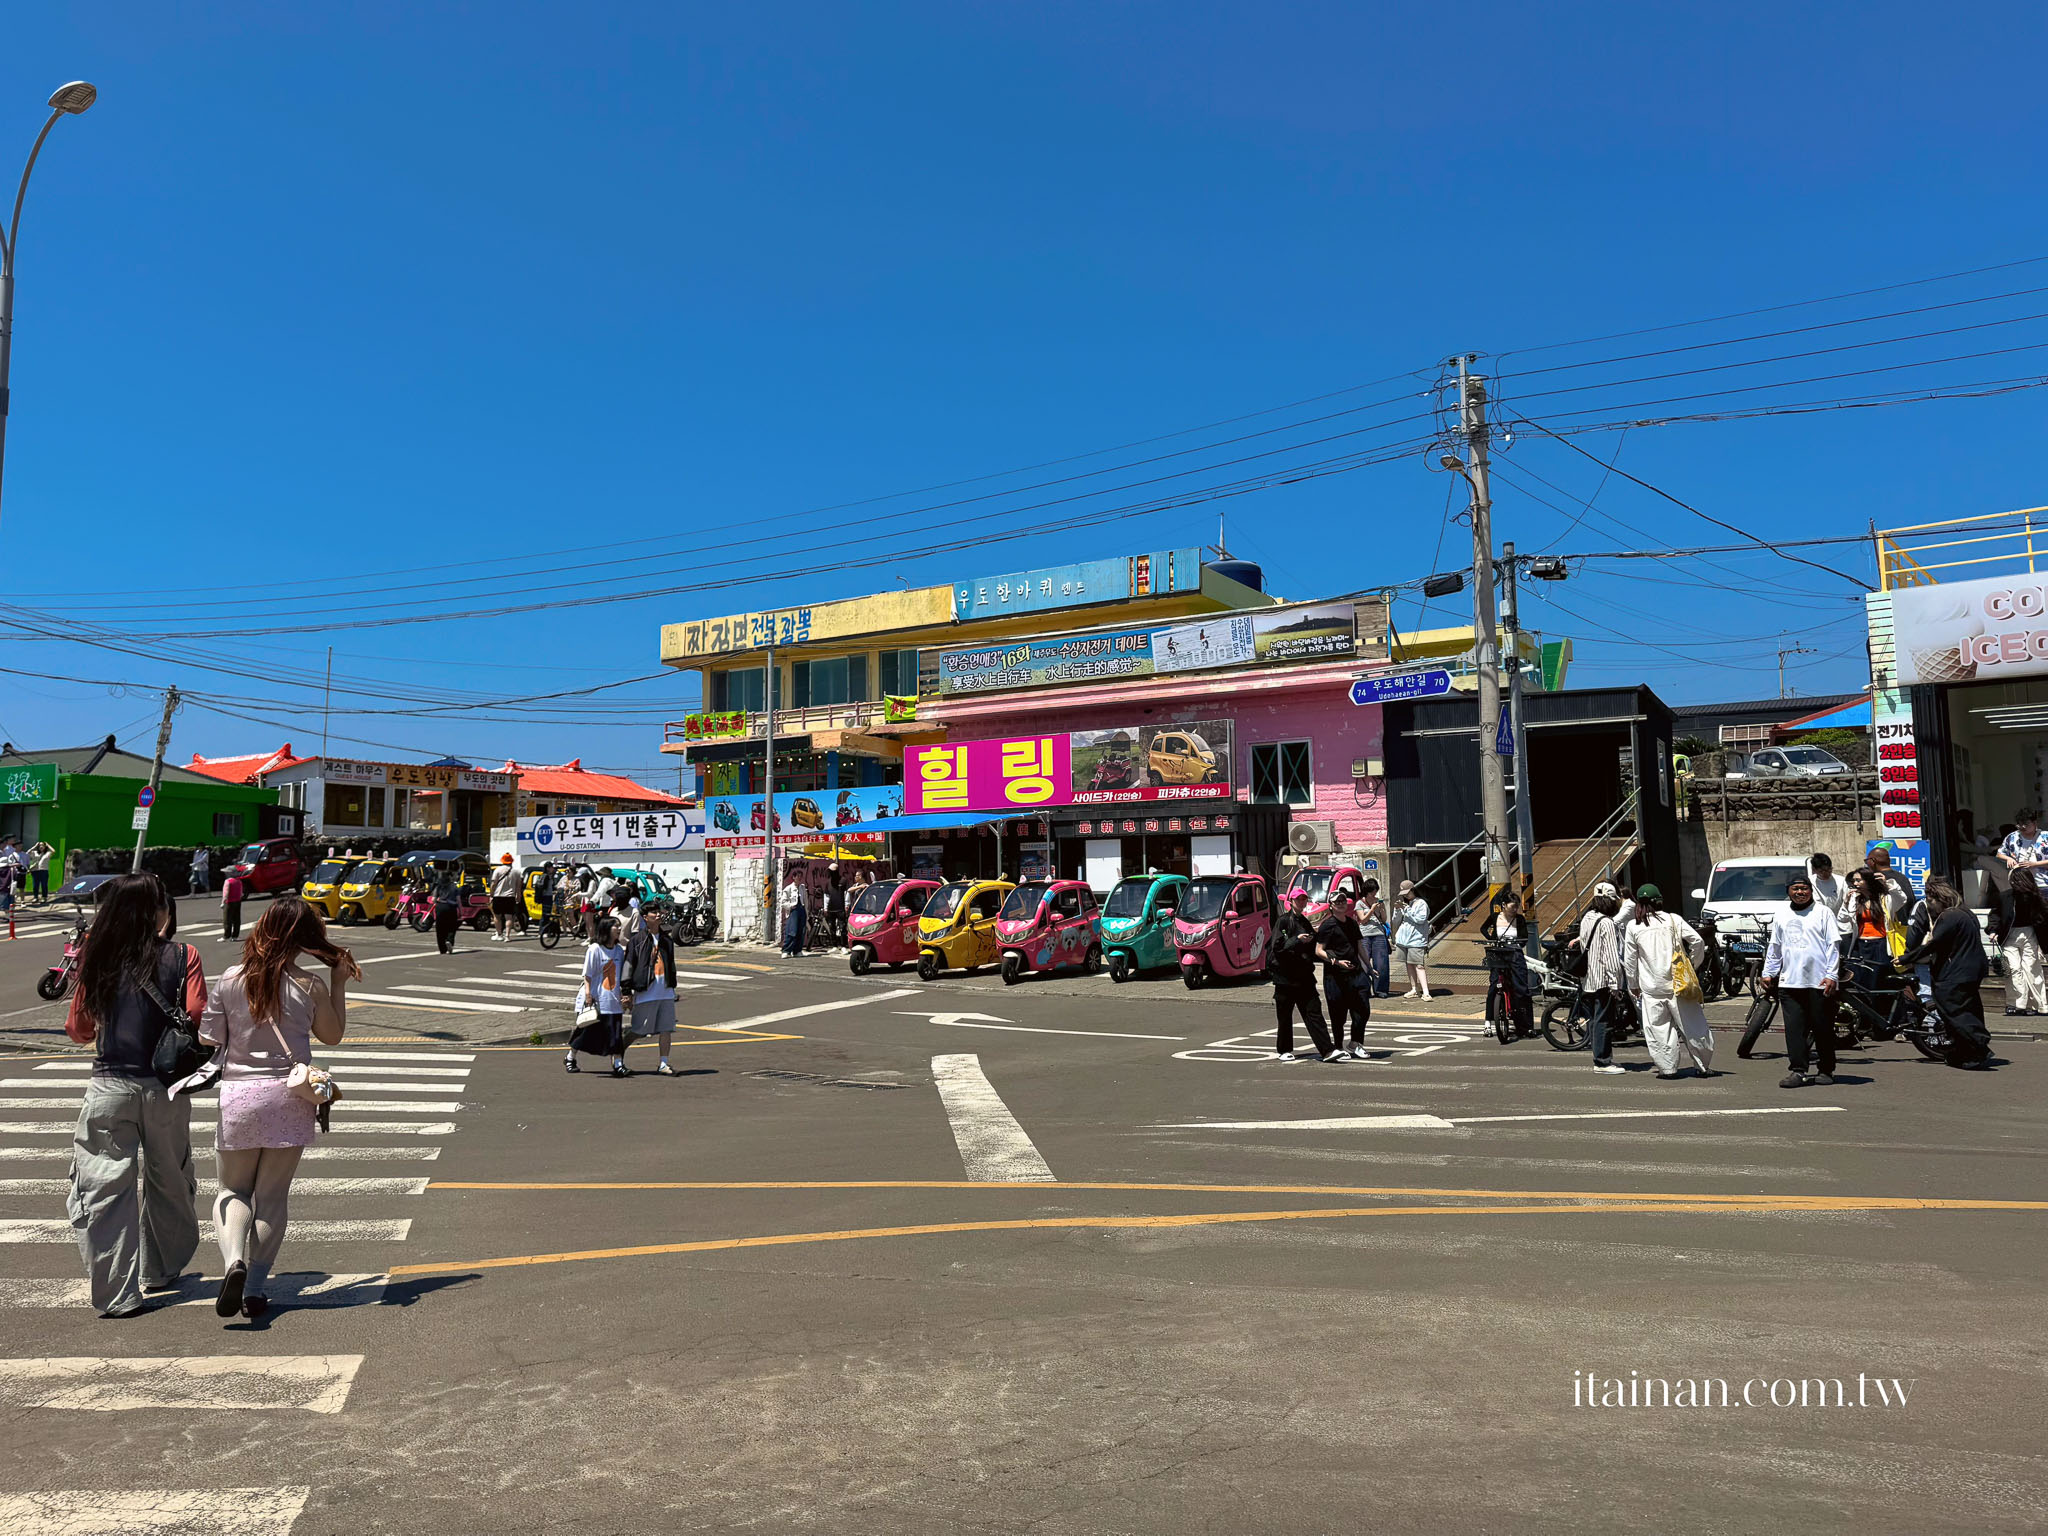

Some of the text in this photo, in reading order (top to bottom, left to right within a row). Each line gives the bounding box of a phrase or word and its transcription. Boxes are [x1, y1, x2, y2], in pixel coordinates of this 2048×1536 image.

[1983, 584, 2048, 621] CO
[999, 644, 1032, 670] 16화
[1058, 637, 1112, 660] 수상자전거
[1114, 633, 1149, 652] 데이트
[951, 668, 1032, 691] 享受水上自行车
[1373, 674, 1427, 691] 우도해안길
[1434, 677, 1445, 687] 70
[1357, 689, 1367, 697] 74
[1378, 688, 1423, 700] Udohaean-gil
[1879, 742, 1917, 760] 2인승
[1880, 765, 1919, 783] 3인승
[1882, 788, 1920, 805] 4인승
[1883, 811, 1921, 828] 5인승
[555, 818, 604, 841] 우도역
